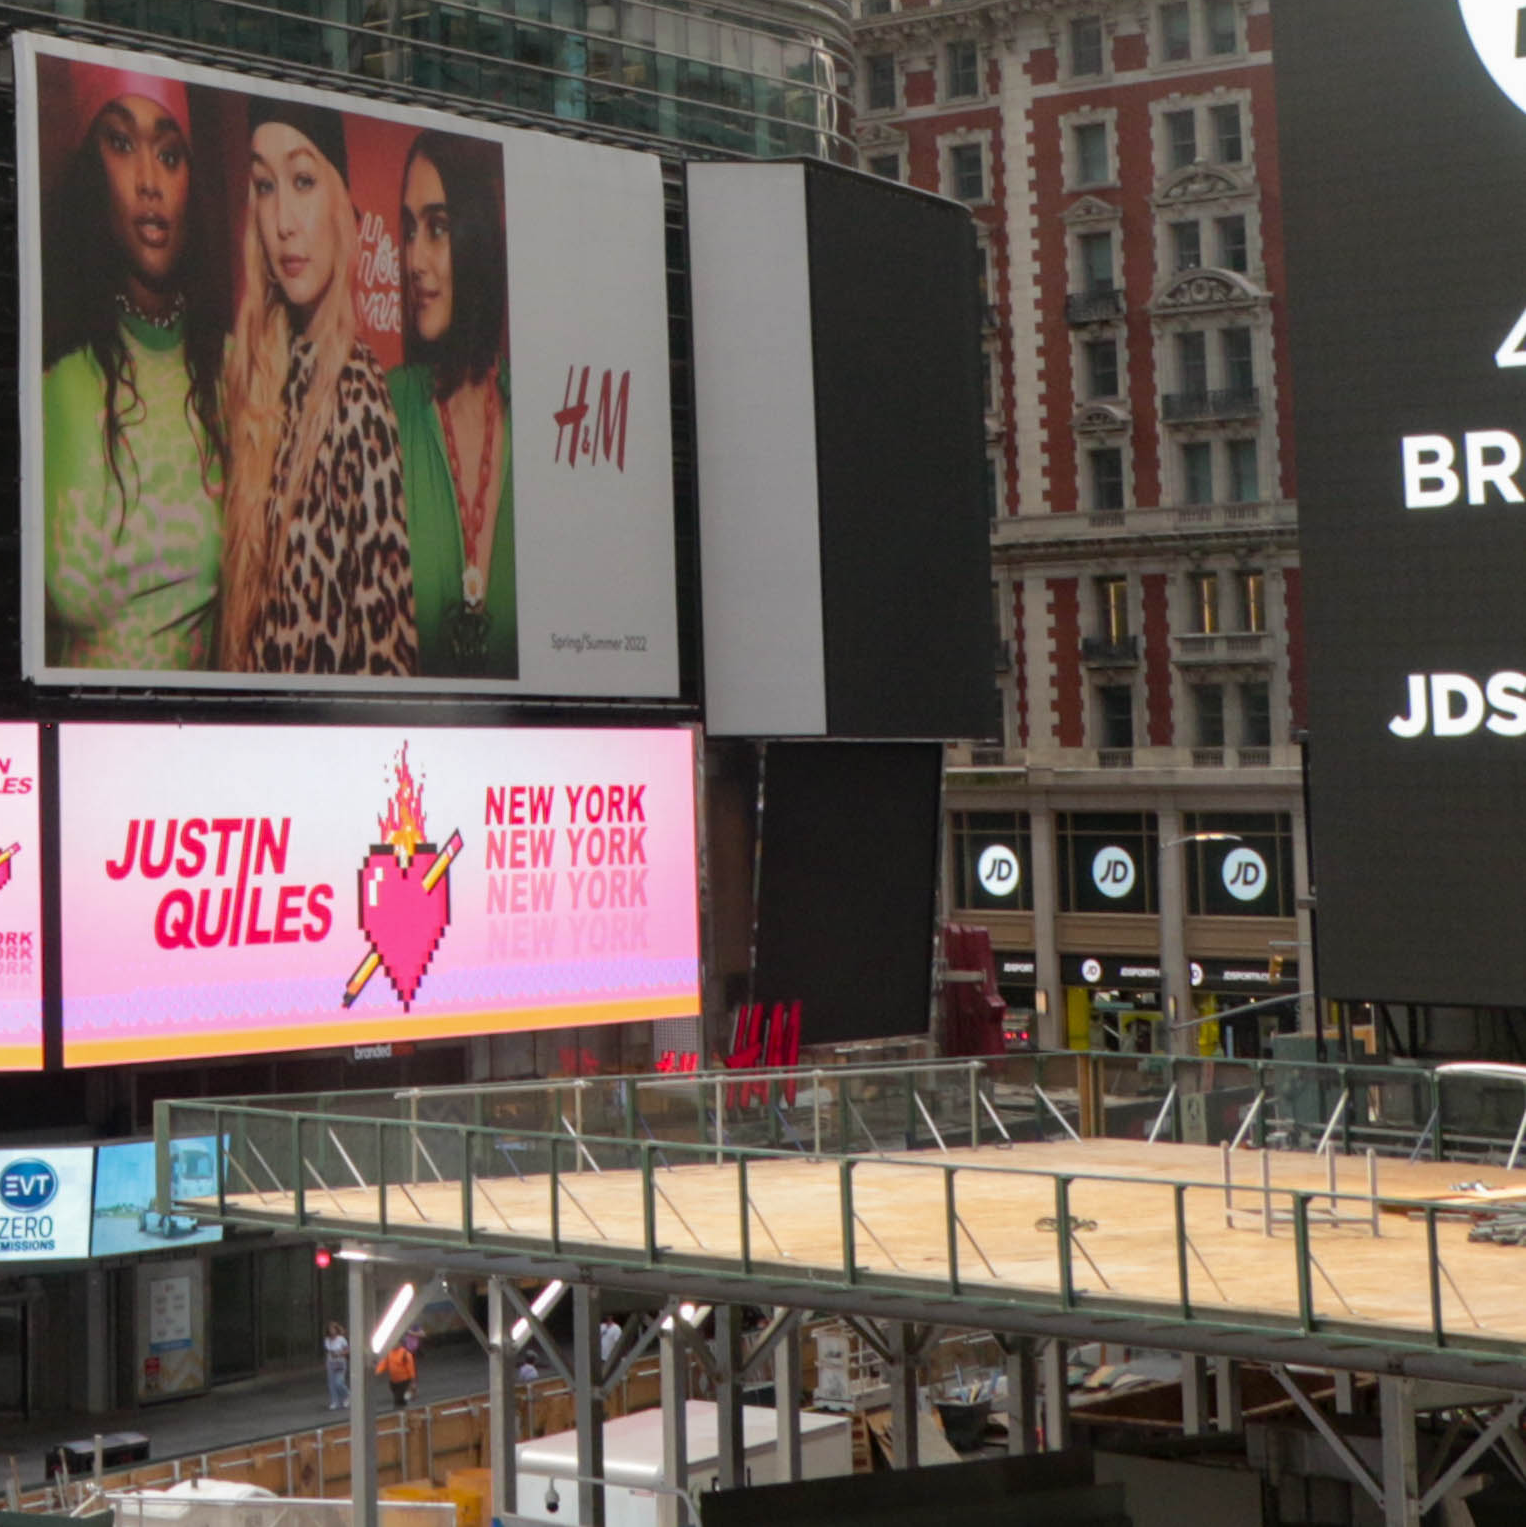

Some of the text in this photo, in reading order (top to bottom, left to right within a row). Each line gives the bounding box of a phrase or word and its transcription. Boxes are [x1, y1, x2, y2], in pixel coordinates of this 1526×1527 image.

[554, 364, 631, 474] H&M
[550, 632, 648, 653] Spring/Summer 2022
[485, 784, 647, 825] NEW YORK
[105, 817, 292, 882] JUSTIN
[485, 826, 648, 869] NEW YORK
[486, 868, 649, 914] NEW YORK
[986, 859, 1012, 882] JD
[1100, 859, 1128, 883] JD
[1229, 861, 1259, 886] JD
[154, 883, 335, 950] QUILES
[5, 1174, 50, 1196] EVT
